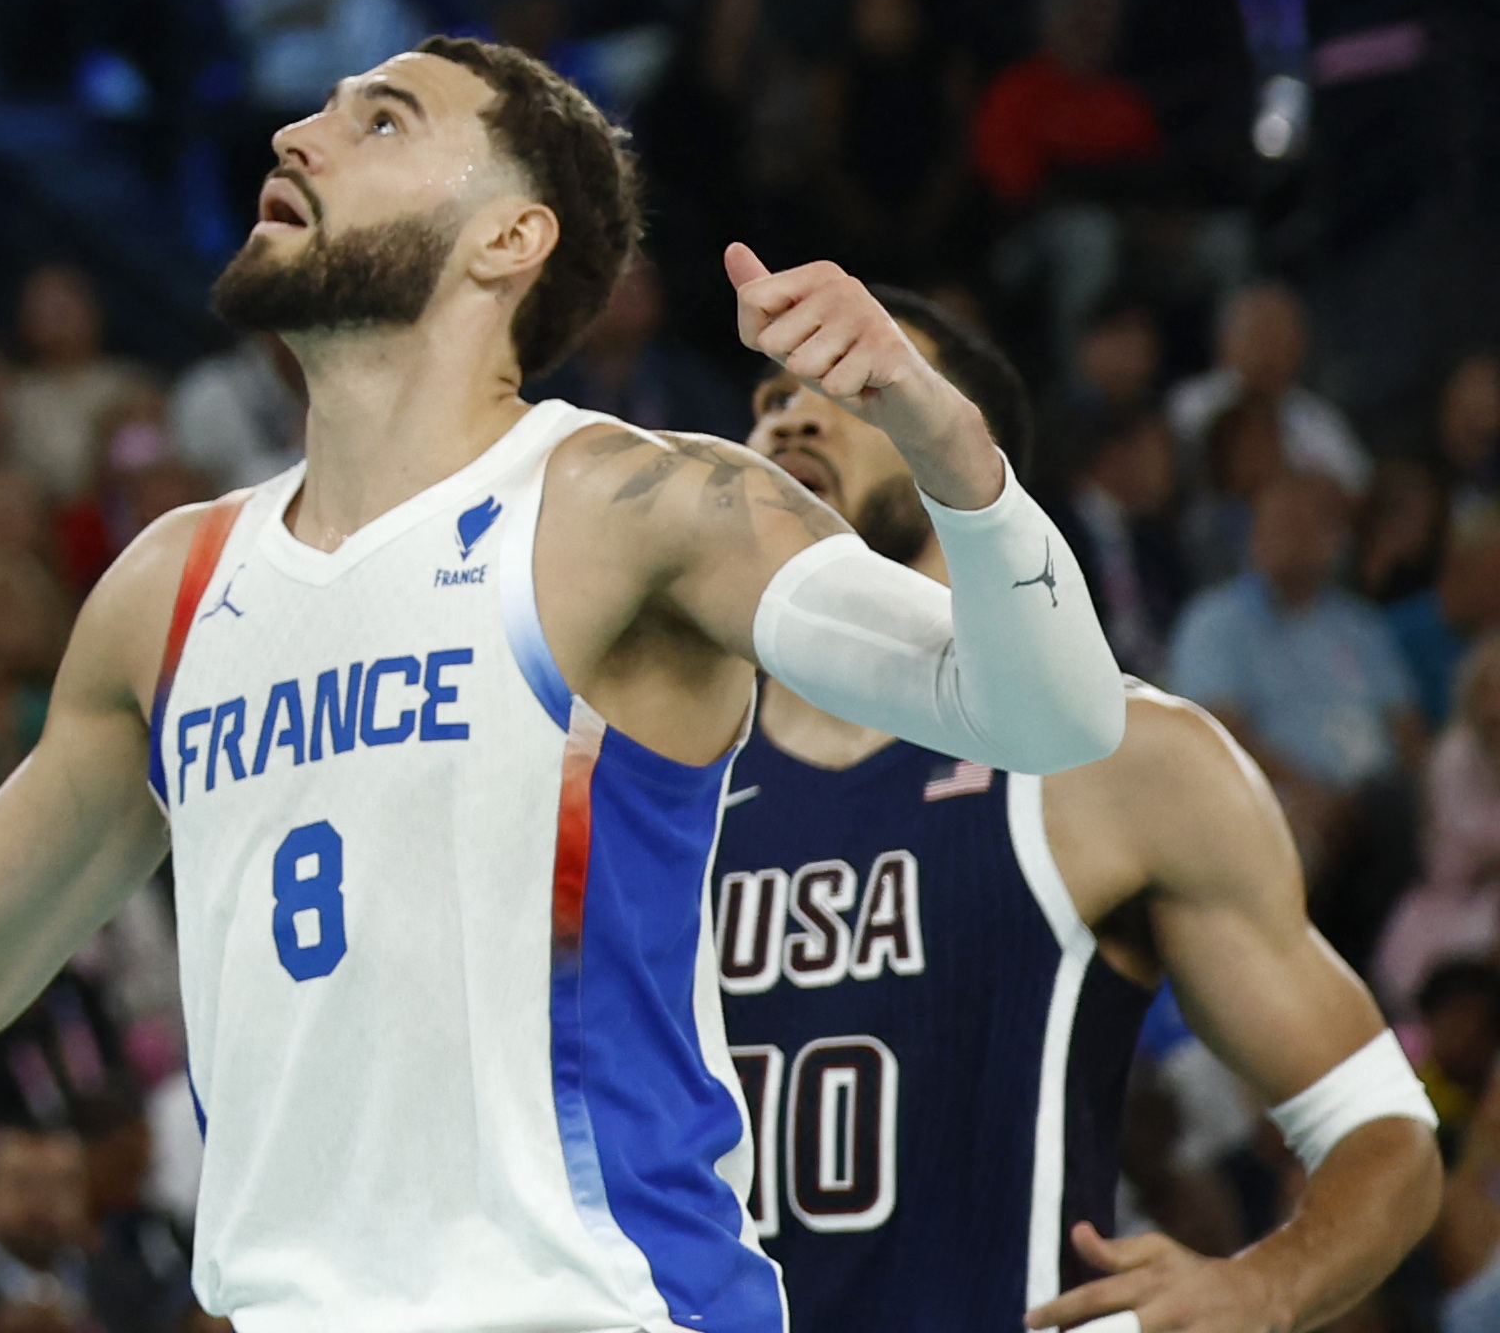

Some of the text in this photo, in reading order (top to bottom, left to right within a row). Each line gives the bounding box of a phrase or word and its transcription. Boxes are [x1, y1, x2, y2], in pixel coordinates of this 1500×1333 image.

[434, 565, 488, 589] FRANCE
[176, 646, 473, 805] FRANCE
[272, 819, 348, 983] 8
[718, 848, 926, 996] USA
[728, 1033, 899, 1239] 10
